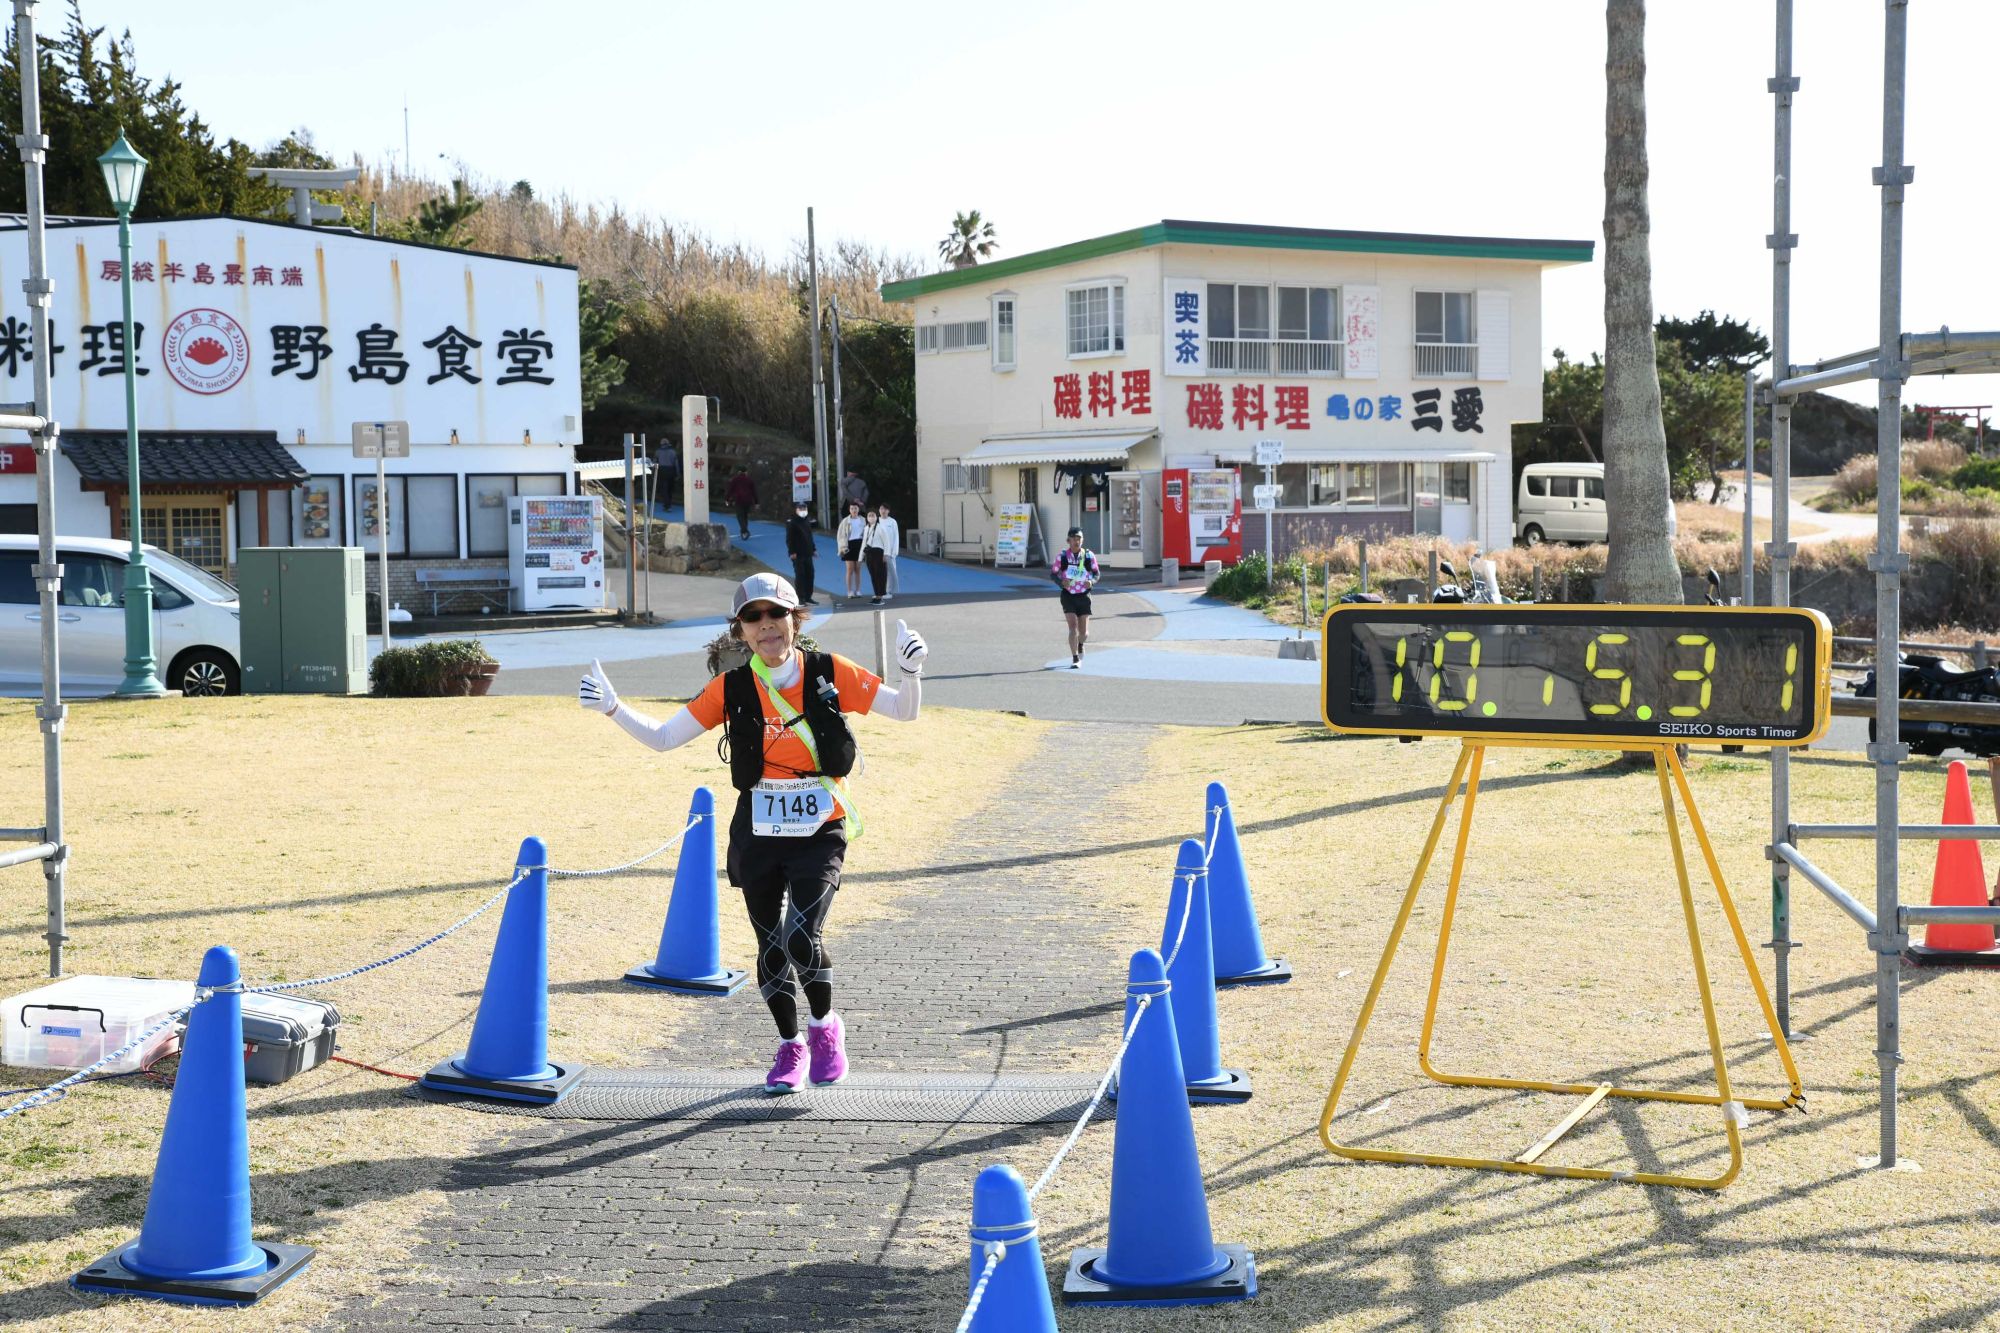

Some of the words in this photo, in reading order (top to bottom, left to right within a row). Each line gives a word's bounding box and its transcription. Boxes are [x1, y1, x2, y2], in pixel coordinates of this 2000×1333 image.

[101, 260, 304, 287] 房総半島最南端
[1174, 291, 1200, 364] 喫茶
[270, 323, 555, 386] 野島食堂
[176, 366, 203, 388] NOJIMA
[205, 366, 240, 388] SHOKUDO
[1053, 369, 1152, 420] 磯料理
[1186, 383, 1311, 431] 磯料理
[1326, 394, 1402, 421] 亀の家
[1411, 386, 1484, 434] 三愛
[1659, 723, 1713, 735] SEIKO
[1716, 725, 1757, 737] Sports
[1761, 726, 1798, 738] Timer
[764, 794, 818, 817] 7148
